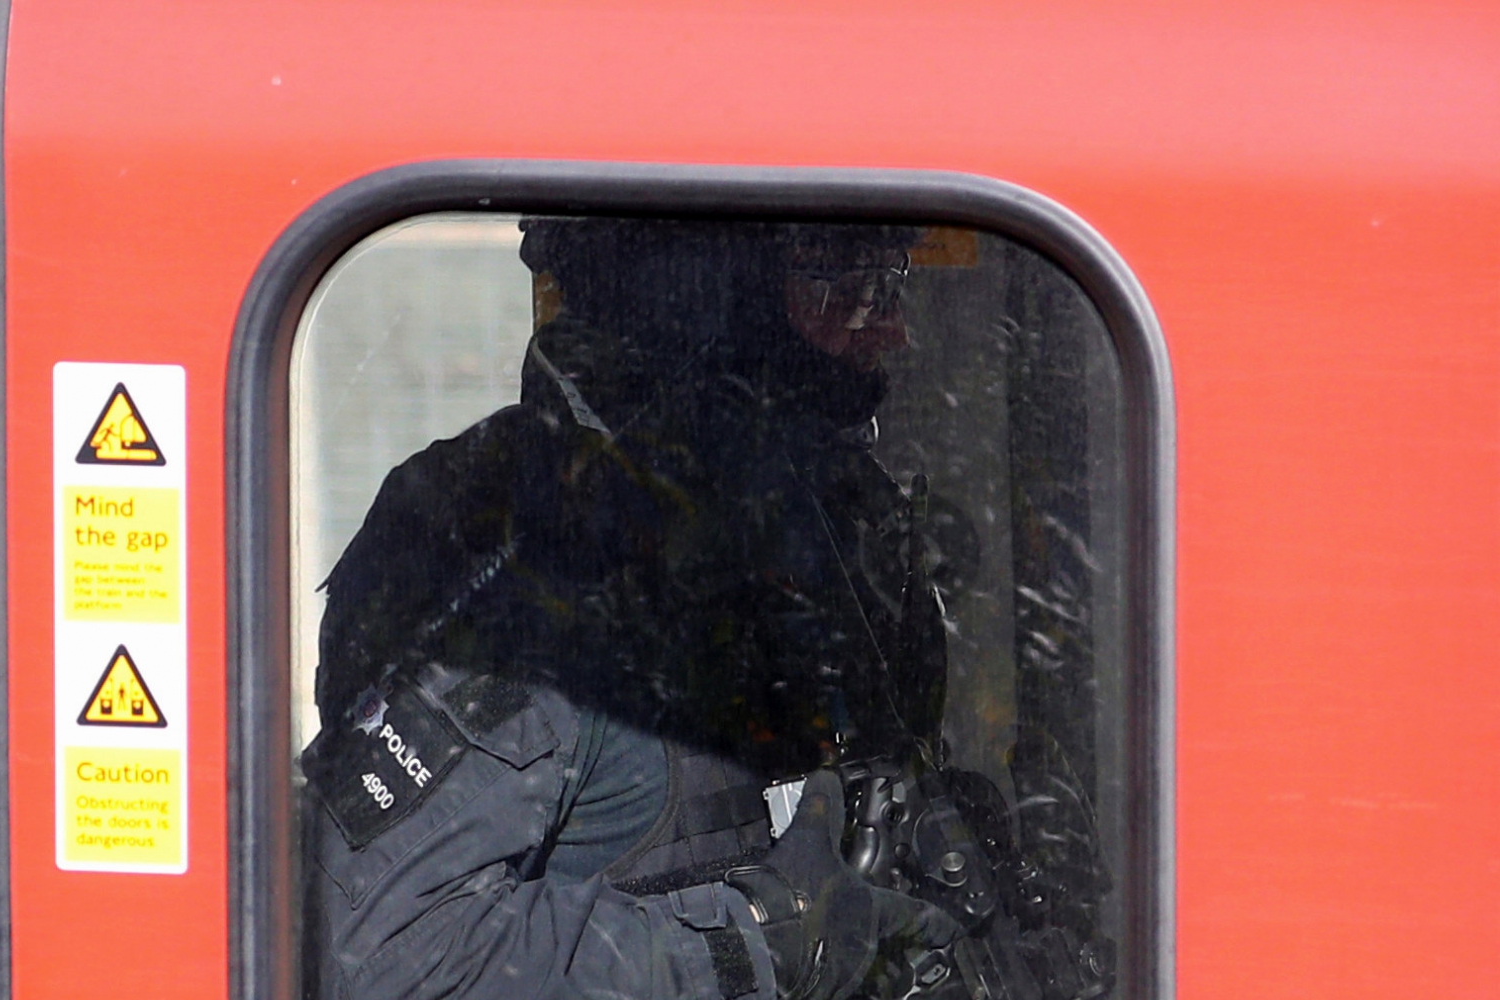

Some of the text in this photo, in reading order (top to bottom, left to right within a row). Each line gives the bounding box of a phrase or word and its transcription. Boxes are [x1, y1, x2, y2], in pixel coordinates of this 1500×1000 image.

[76, 495, 134, 517] Mind
[75, 526, 169, 552] the gap
[379, 723, 432, 788] POLICE
[77, 761, 169, 783] Caution
[361, 772, 395, 810] 4900
[76, 796, 169, 815] Obstructing
[76, 815, 169, 830] the doors is
[76, 833, 155, 849] dangerous
